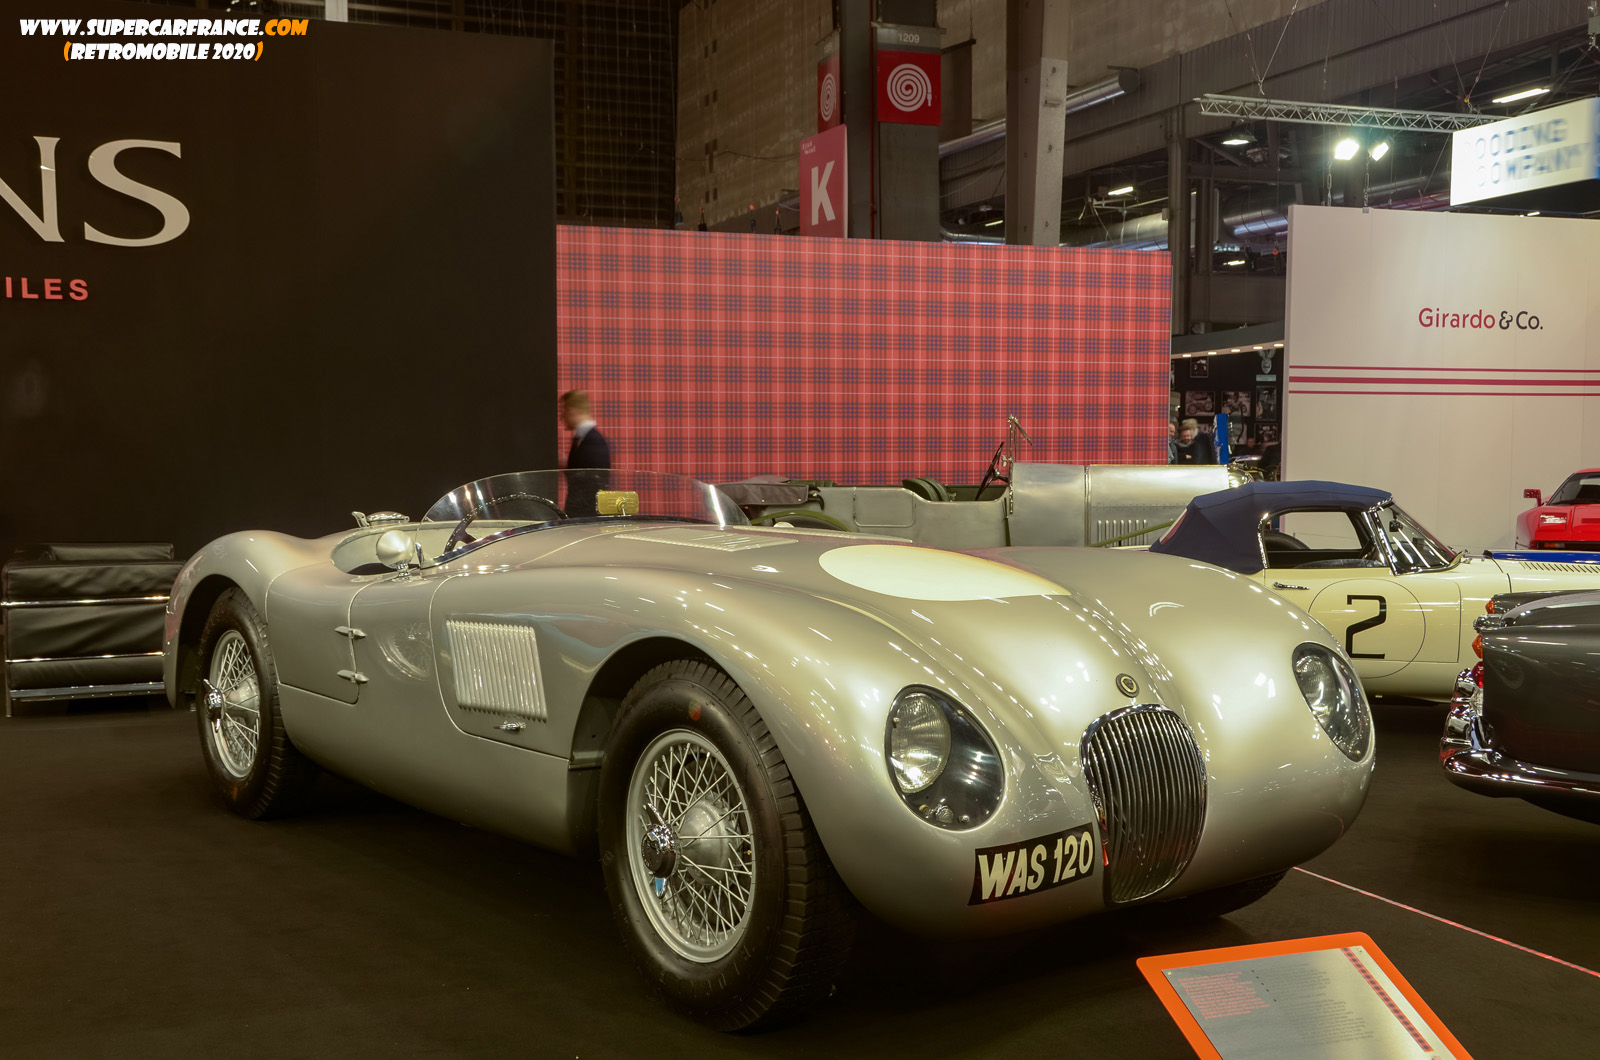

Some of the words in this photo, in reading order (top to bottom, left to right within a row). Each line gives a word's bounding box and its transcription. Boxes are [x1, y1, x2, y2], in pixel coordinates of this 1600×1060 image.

[898, 32, 920, 44] 1209
[811, 160, 836, 226] K
[5, 276, 89, 301] ILES
[1345, 594, 1387, 659] 2
[978, 843, 1047, 900] WAS
[1053, 831, 1094, 884] 120
